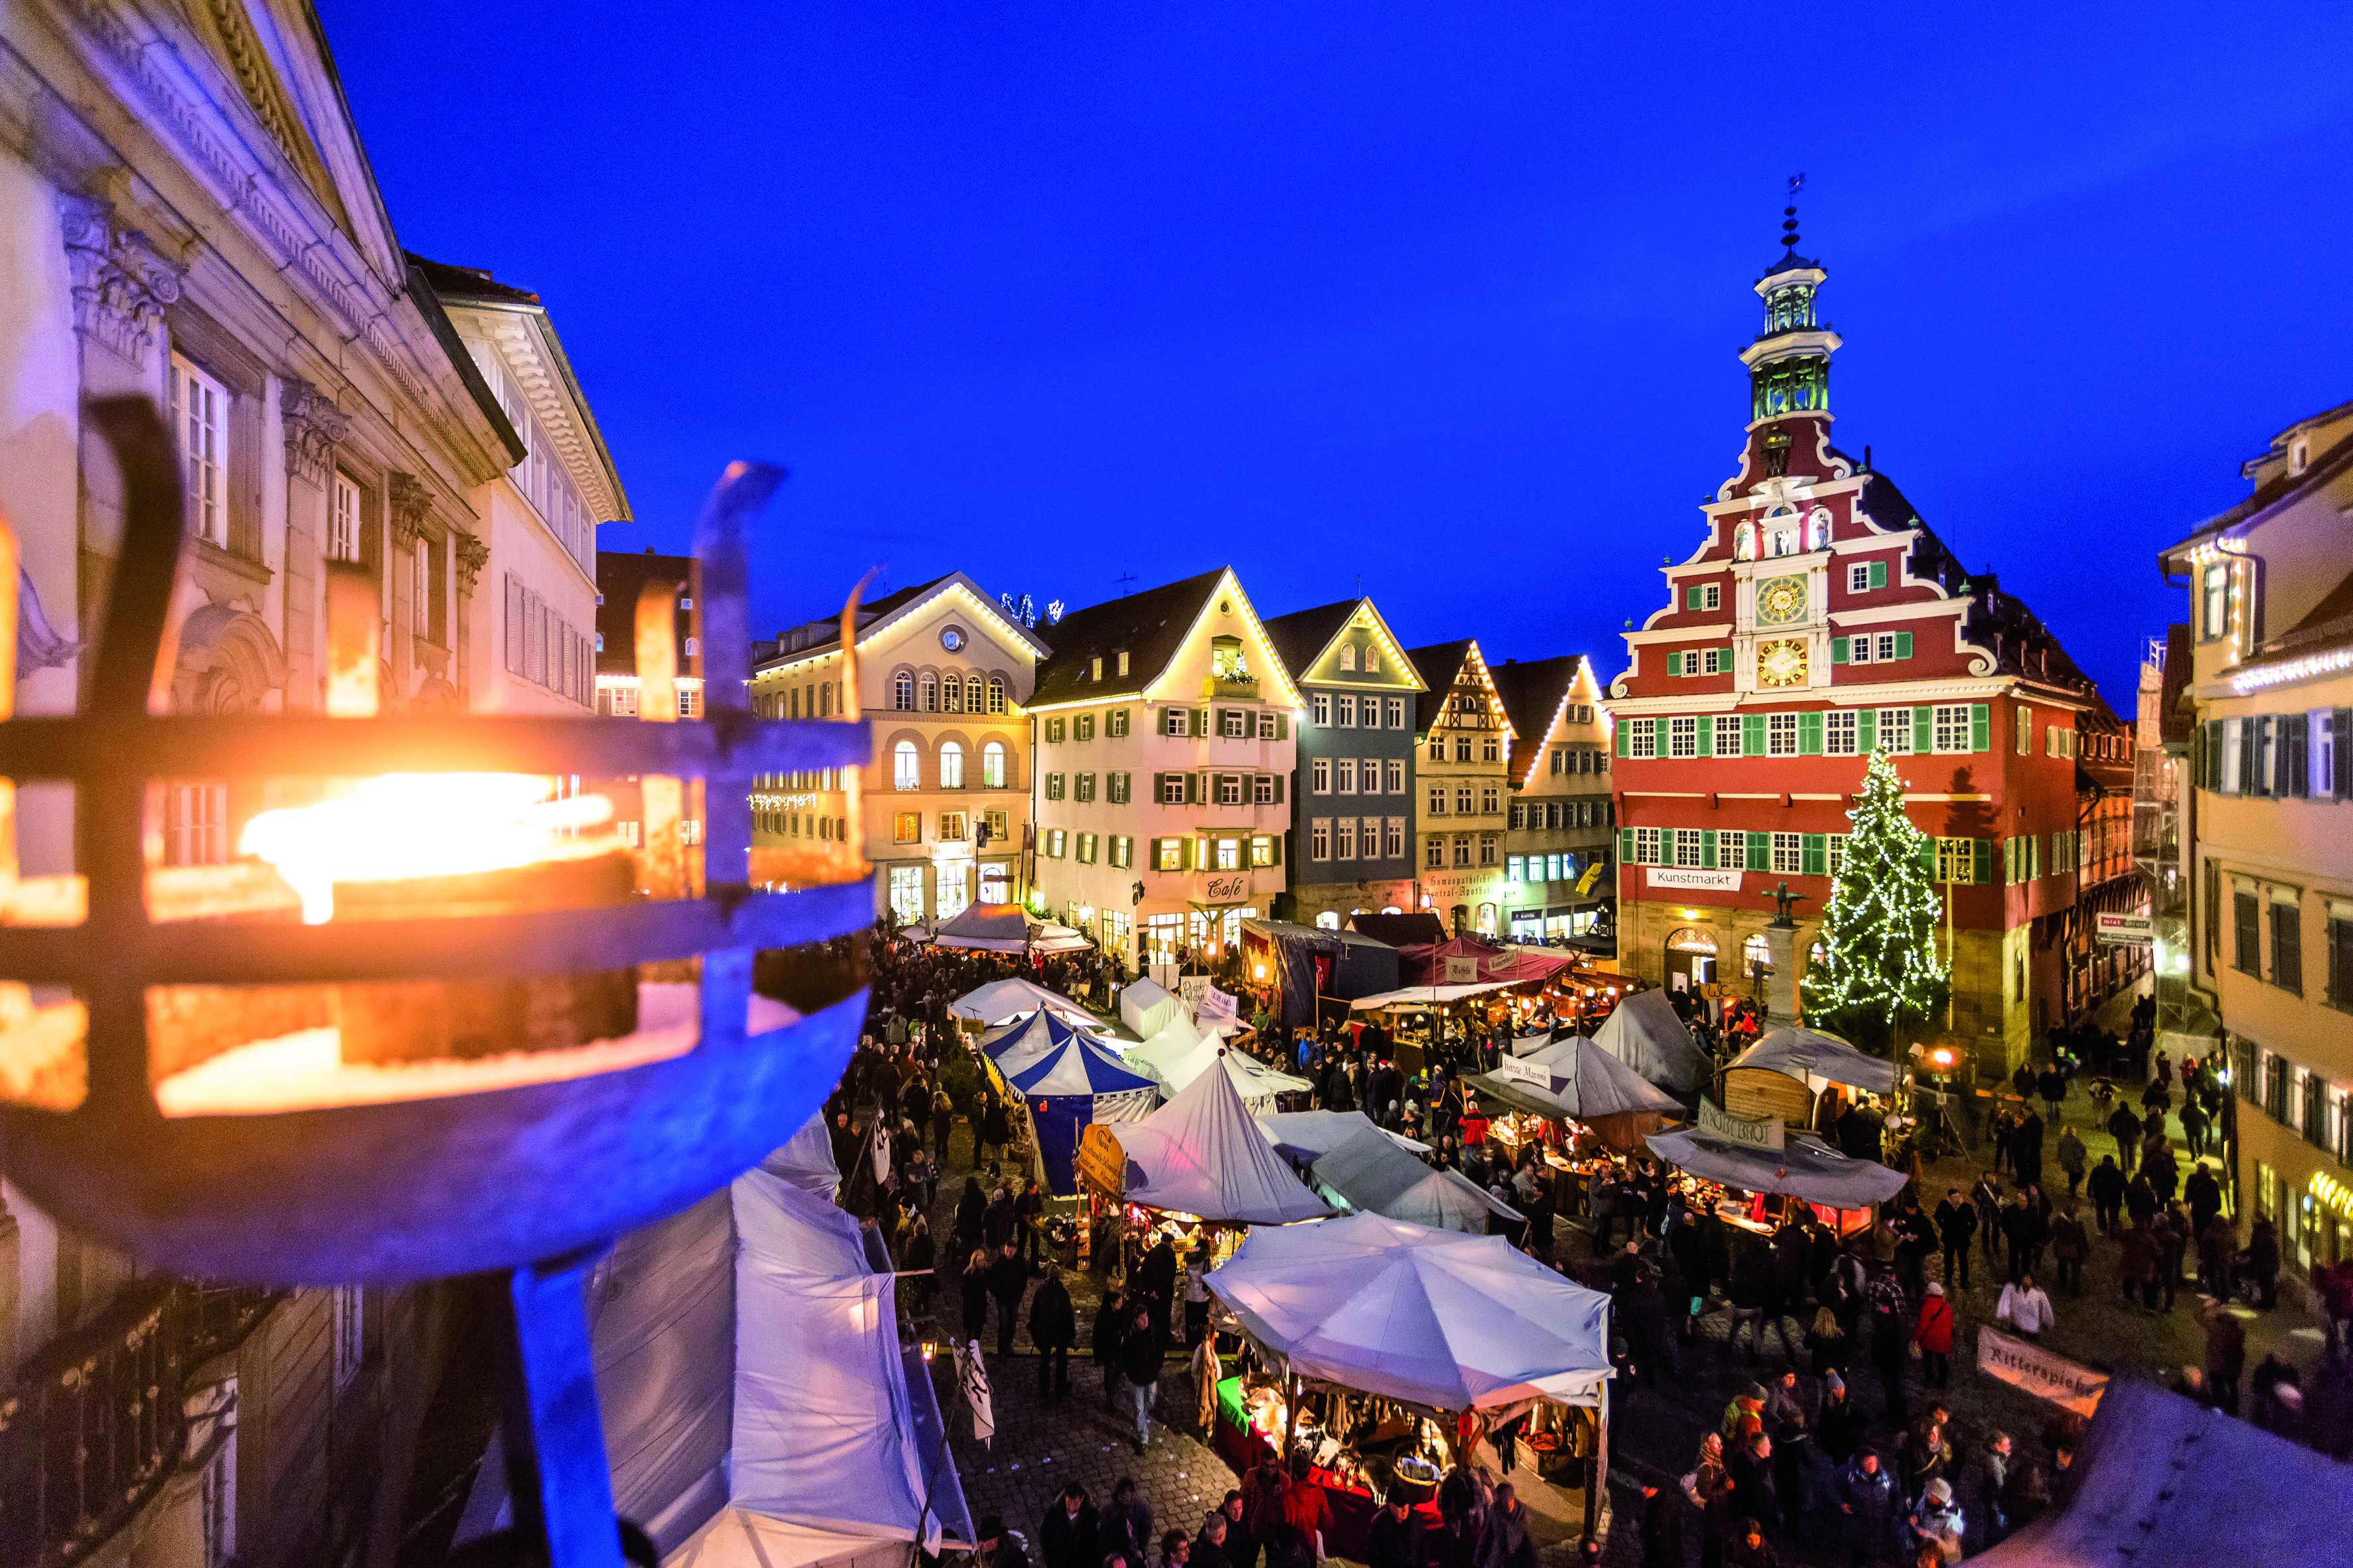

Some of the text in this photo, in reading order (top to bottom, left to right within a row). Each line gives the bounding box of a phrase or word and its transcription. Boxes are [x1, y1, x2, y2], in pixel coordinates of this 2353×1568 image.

[1658, 872, 1730, 885] Kunstmarkt
[1208, 877, 1244, 900] Café
[1705, 983, 1732, 997] WC
[1523, 1066, 1546, 1081] Maroni
